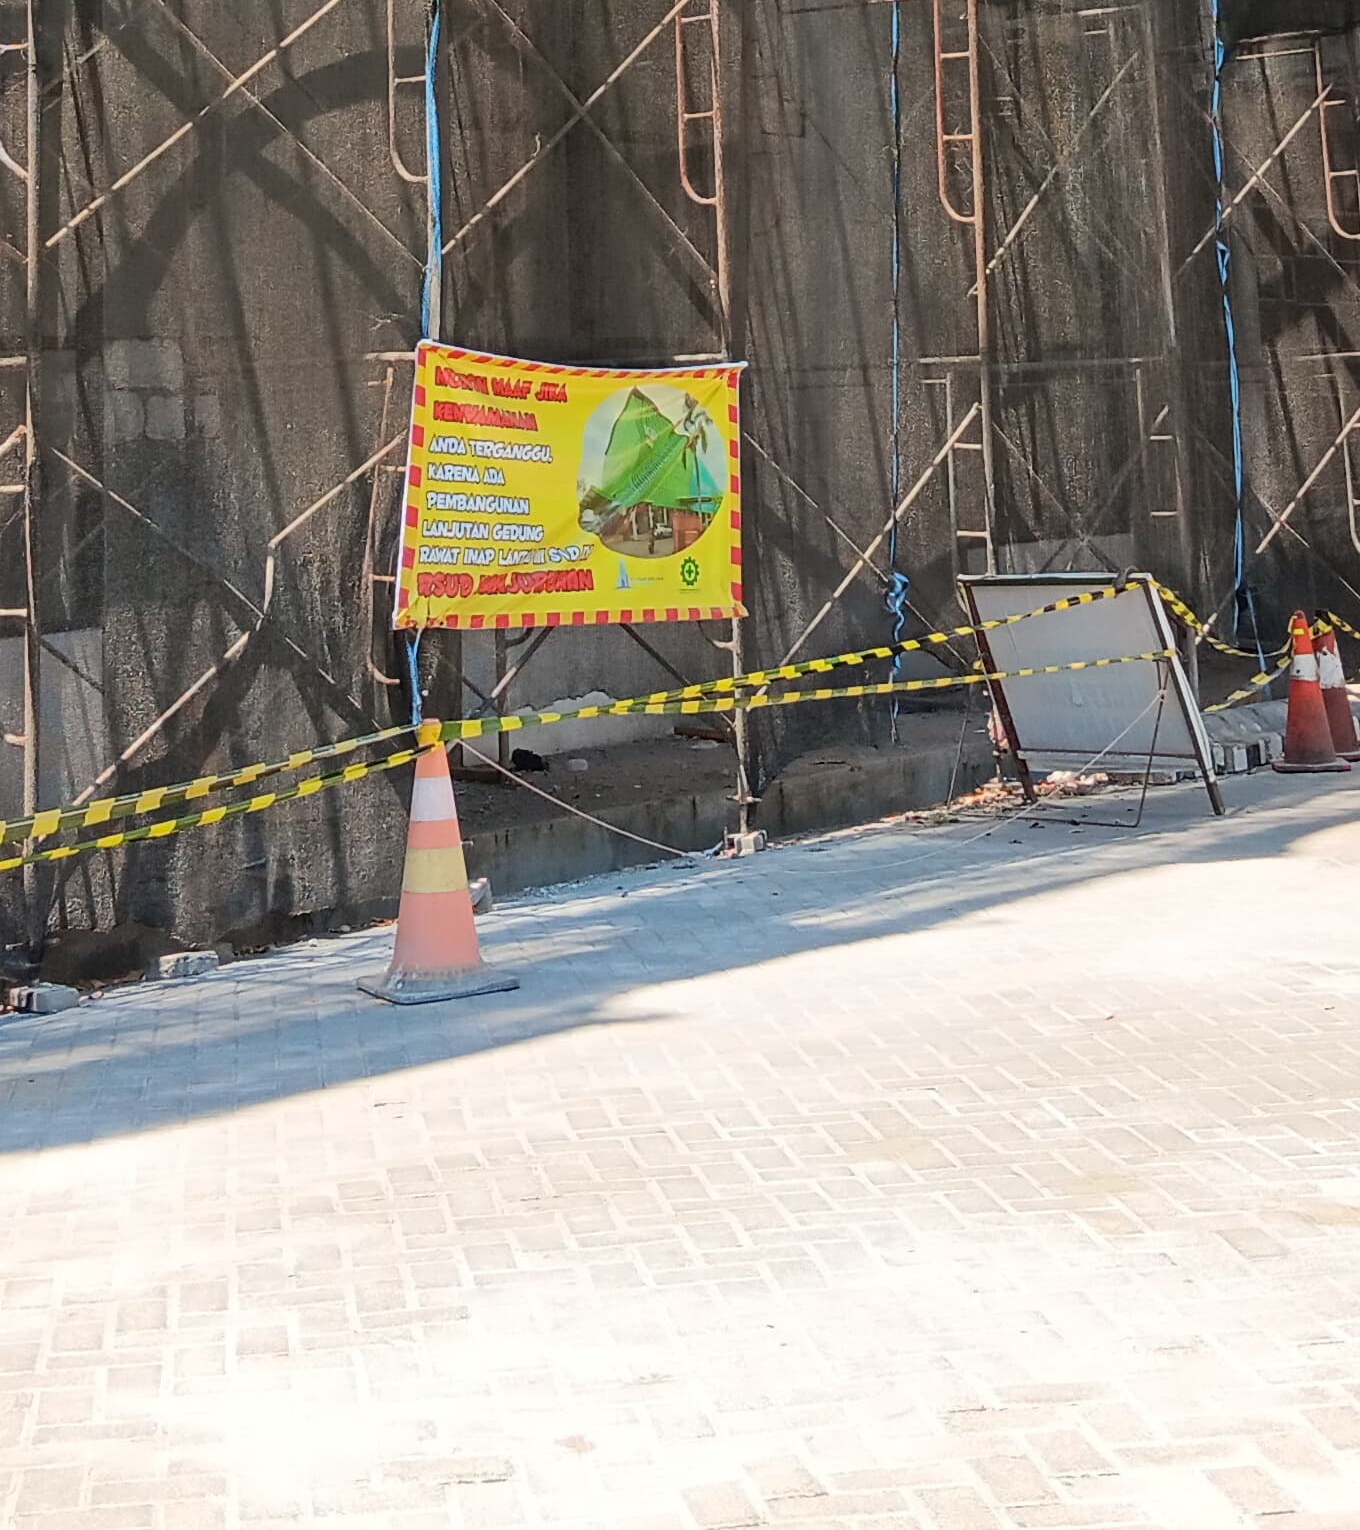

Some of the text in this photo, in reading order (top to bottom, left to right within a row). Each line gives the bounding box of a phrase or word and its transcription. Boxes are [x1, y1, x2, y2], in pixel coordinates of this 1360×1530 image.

[491, 376, 533, 400] MAAF
[535, 381, 568, 403] JIKA
[429, 434, 466, 455] ANDA
[427, 462, 505, 486] KARENA ADA
[426, 491, 530, 515] PEMBANGUNAN
[422, 519, 544, 542] LANJUTAN GEDUNG
[419, 545, 461, 564] RAWAT
[463, 546, 496, 566] INAP
[417, 572, 474, 598] RSUD
